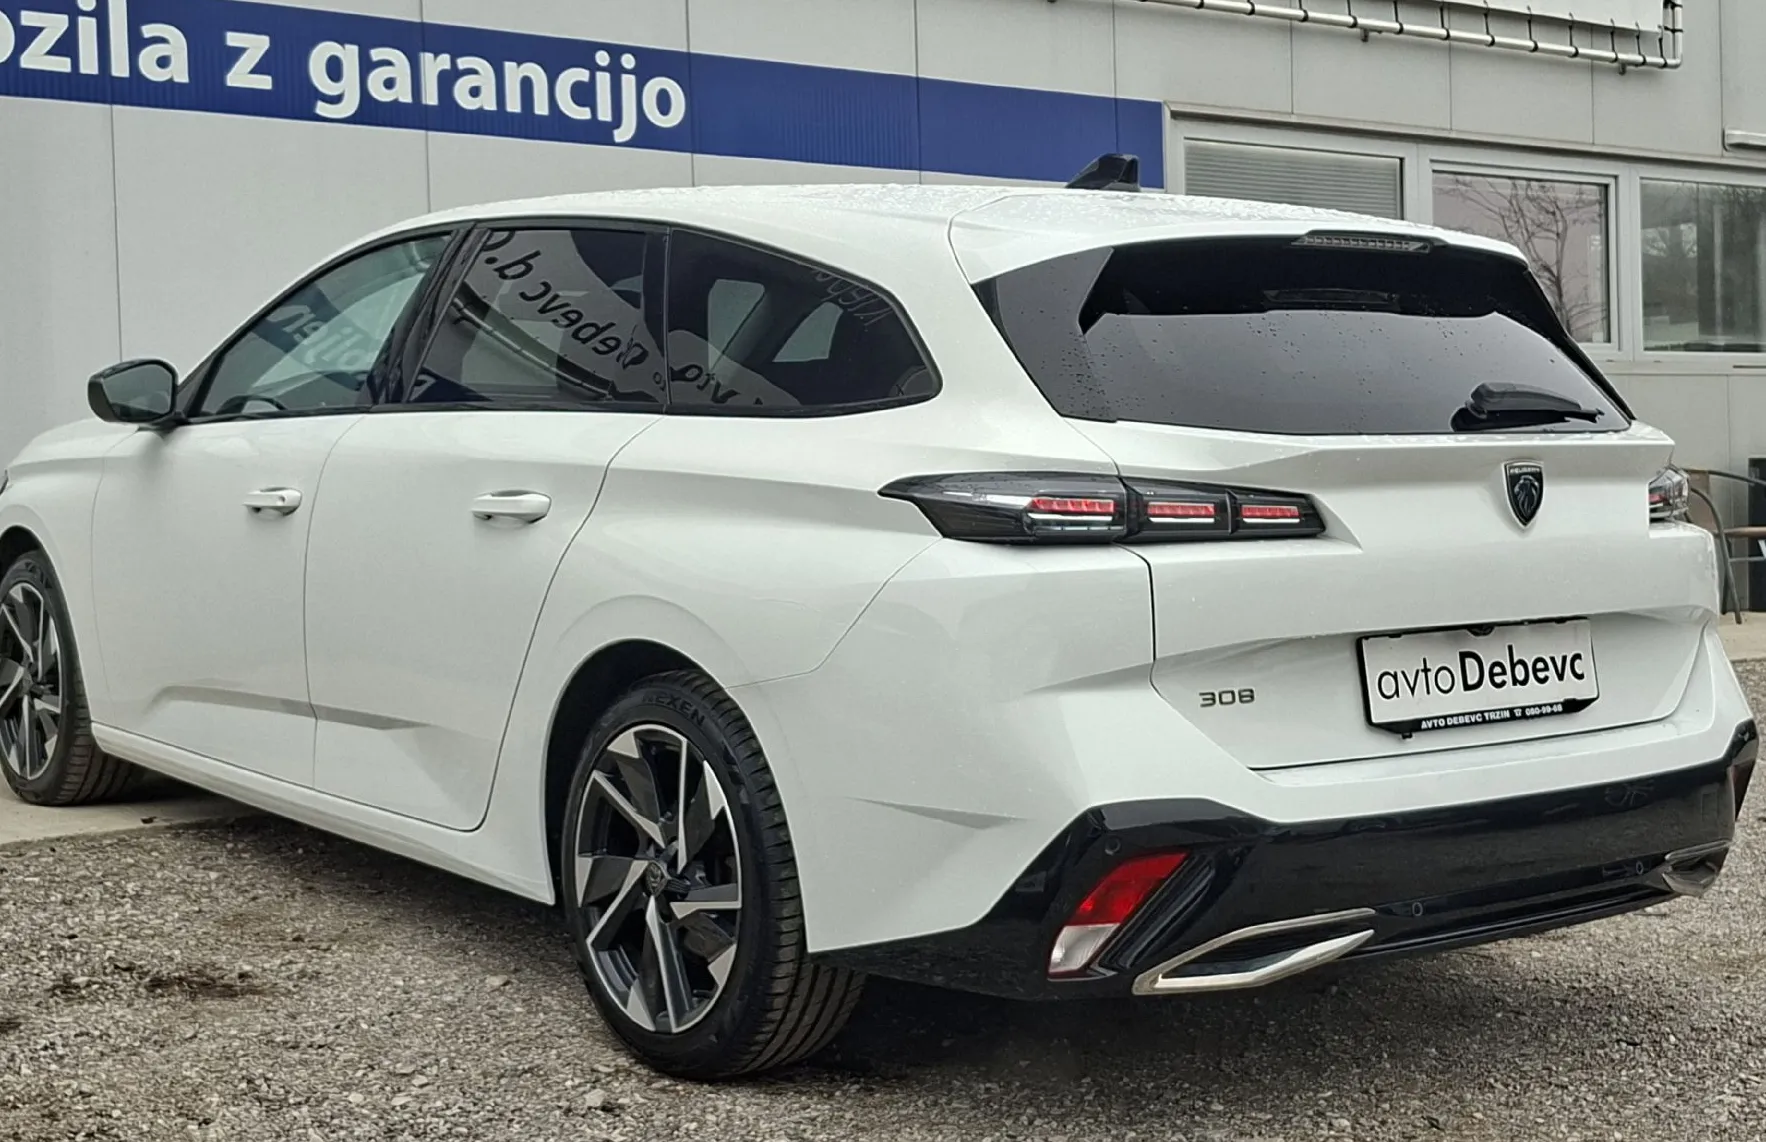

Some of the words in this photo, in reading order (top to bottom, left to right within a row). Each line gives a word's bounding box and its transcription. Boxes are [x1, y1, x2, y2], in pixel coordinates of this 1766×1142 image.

[0, 0, 189, 83] zila
[225, 31, 272, 90] z
[308, 40, 686, 142] garancijo
[1199, 688, 1255, 708] 308
[1421, 718, 1446, 729] AVTO
[1447, 713, 1483, 726] DEBEVC
[1484, 709, 1510, 721] TRZIN
